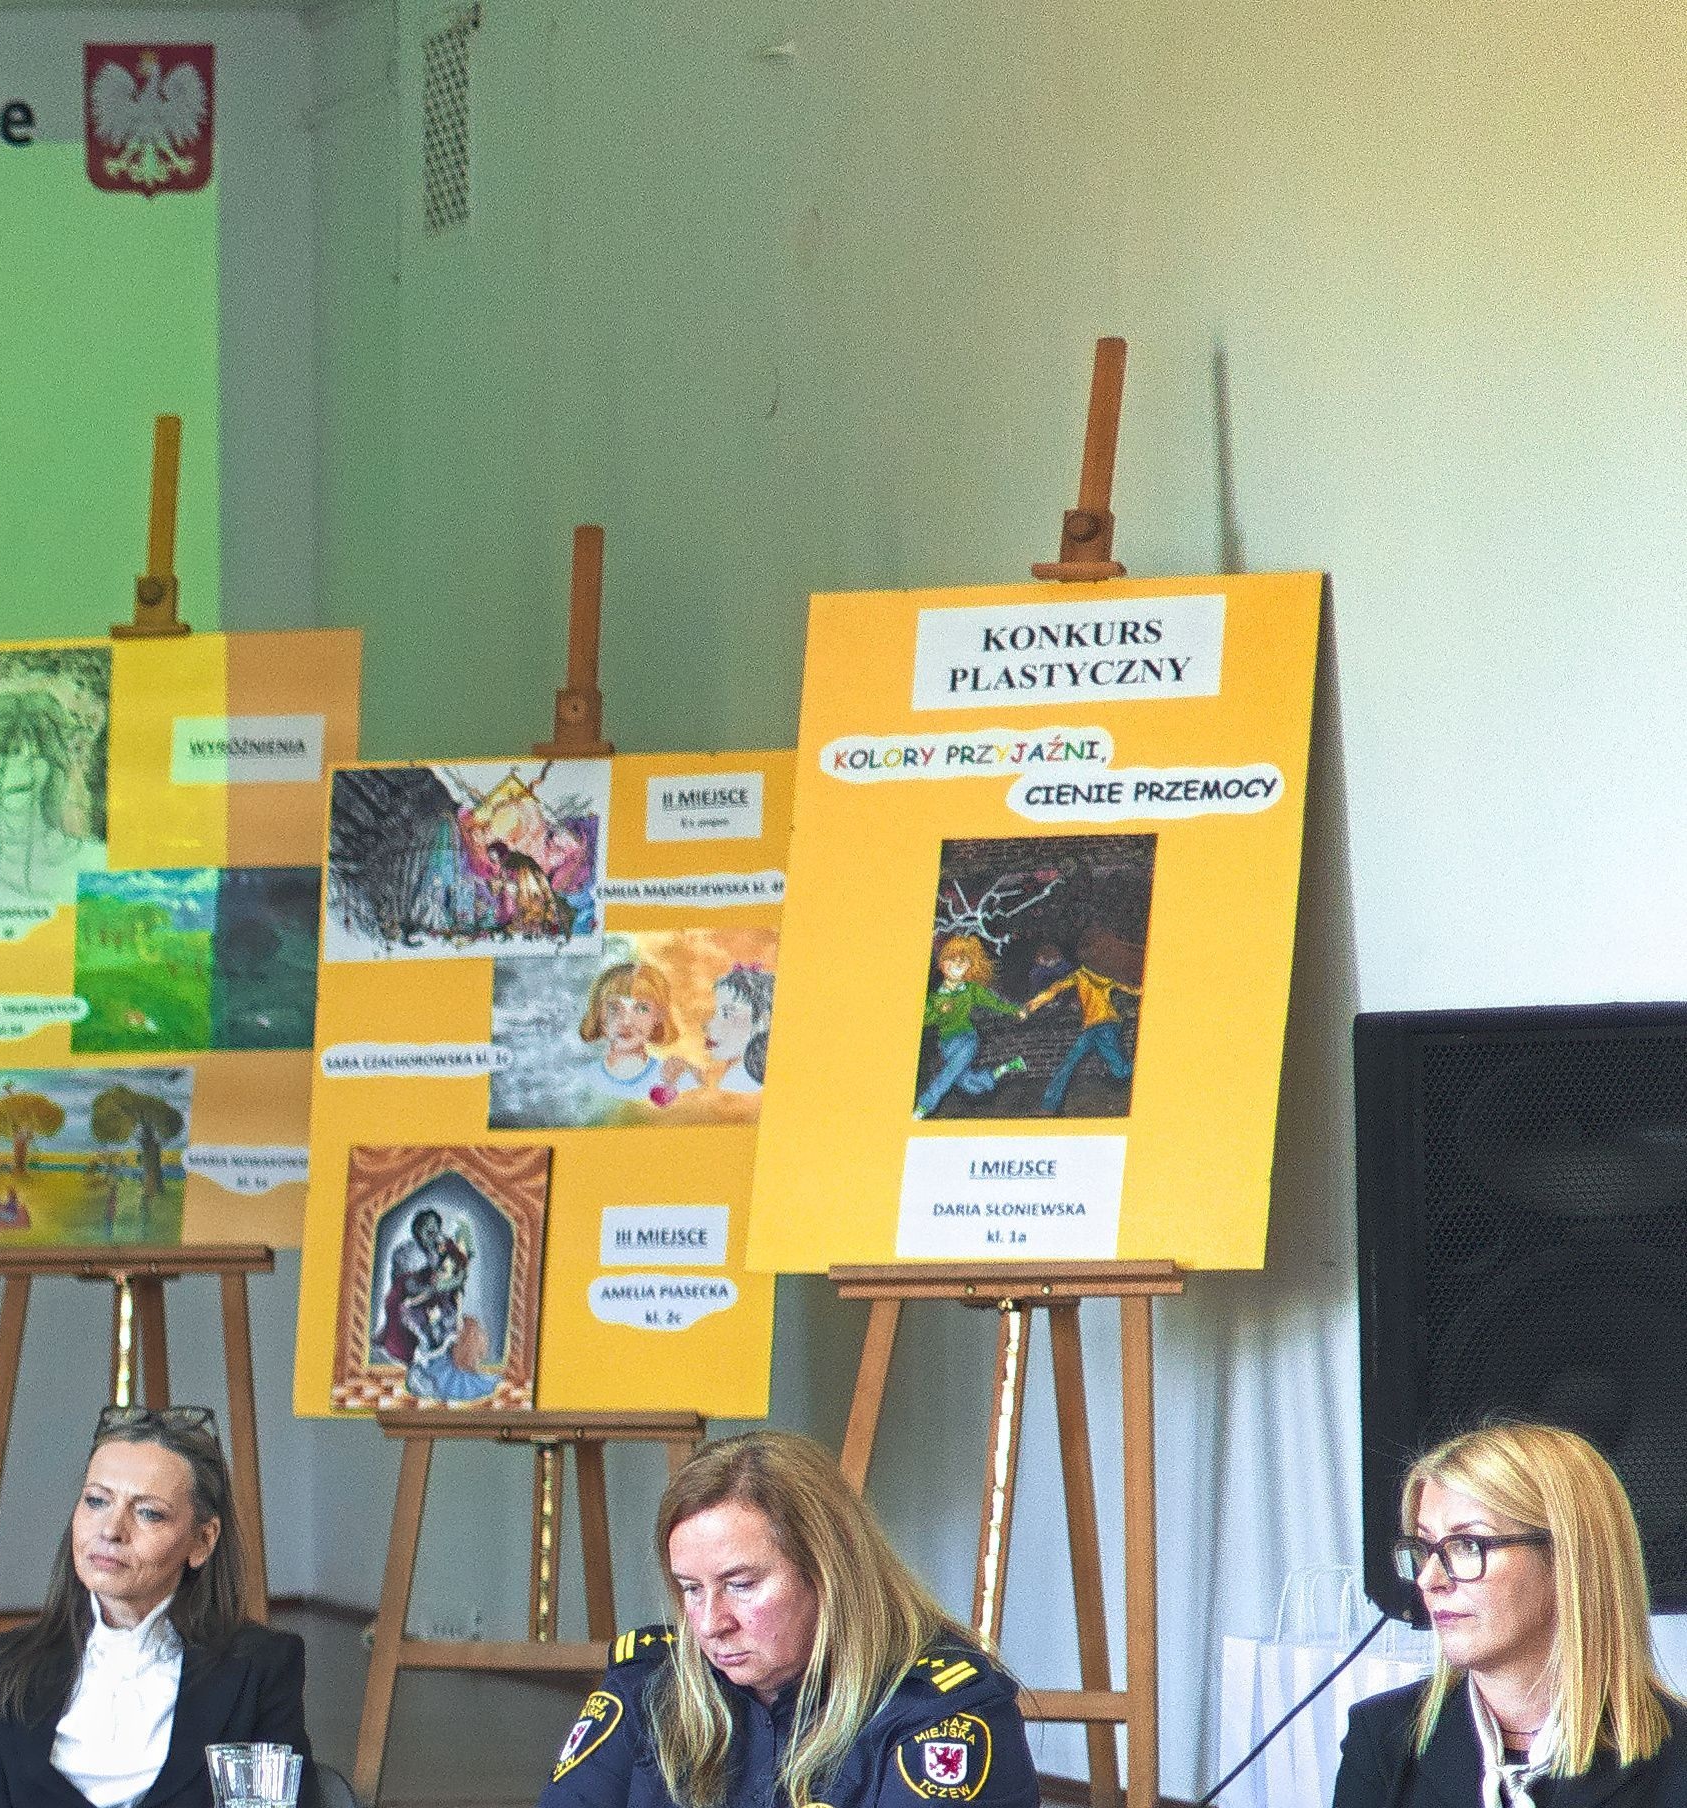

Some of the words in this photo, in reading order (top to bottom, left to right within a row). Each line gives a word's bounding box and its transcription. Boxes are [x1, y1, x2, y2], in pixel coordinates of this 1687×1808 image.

[980, 617, 1164, 654] KONKURS
[947, 656, 1193, 695] PLASTYCZNY
[833, 746, 936, 771] KOLORY
[945, 733, 1108, 766] PRZYJAŹNI,
[678, 787, 749, 808] MIEJSCE
[1024, 780, 1123, 807] CIENIE
[1132, 775, 1278, 803] PRZEMOCY
[325, 1056, 361, 1070] SARA
[981, 1157, 1058, 1179] MIEJSCE
[932, 1201, 981, 1218] DARIA
[984, 1199, 1087, 1218] SŁONIEWSKA
[614, 1229, 633, 1248] III
[637, 1226, 709, 1248] MIEJSCE
[986, 1228, 1005, 1246] kl.
[600, 1282, 655, 1301] AMELIA
[658, 1281, 730, 1300] PIASECKA
[914, 1726, 976, 1745] MIEJSKA
[919, 1779, 971, 1799] TCZEW
